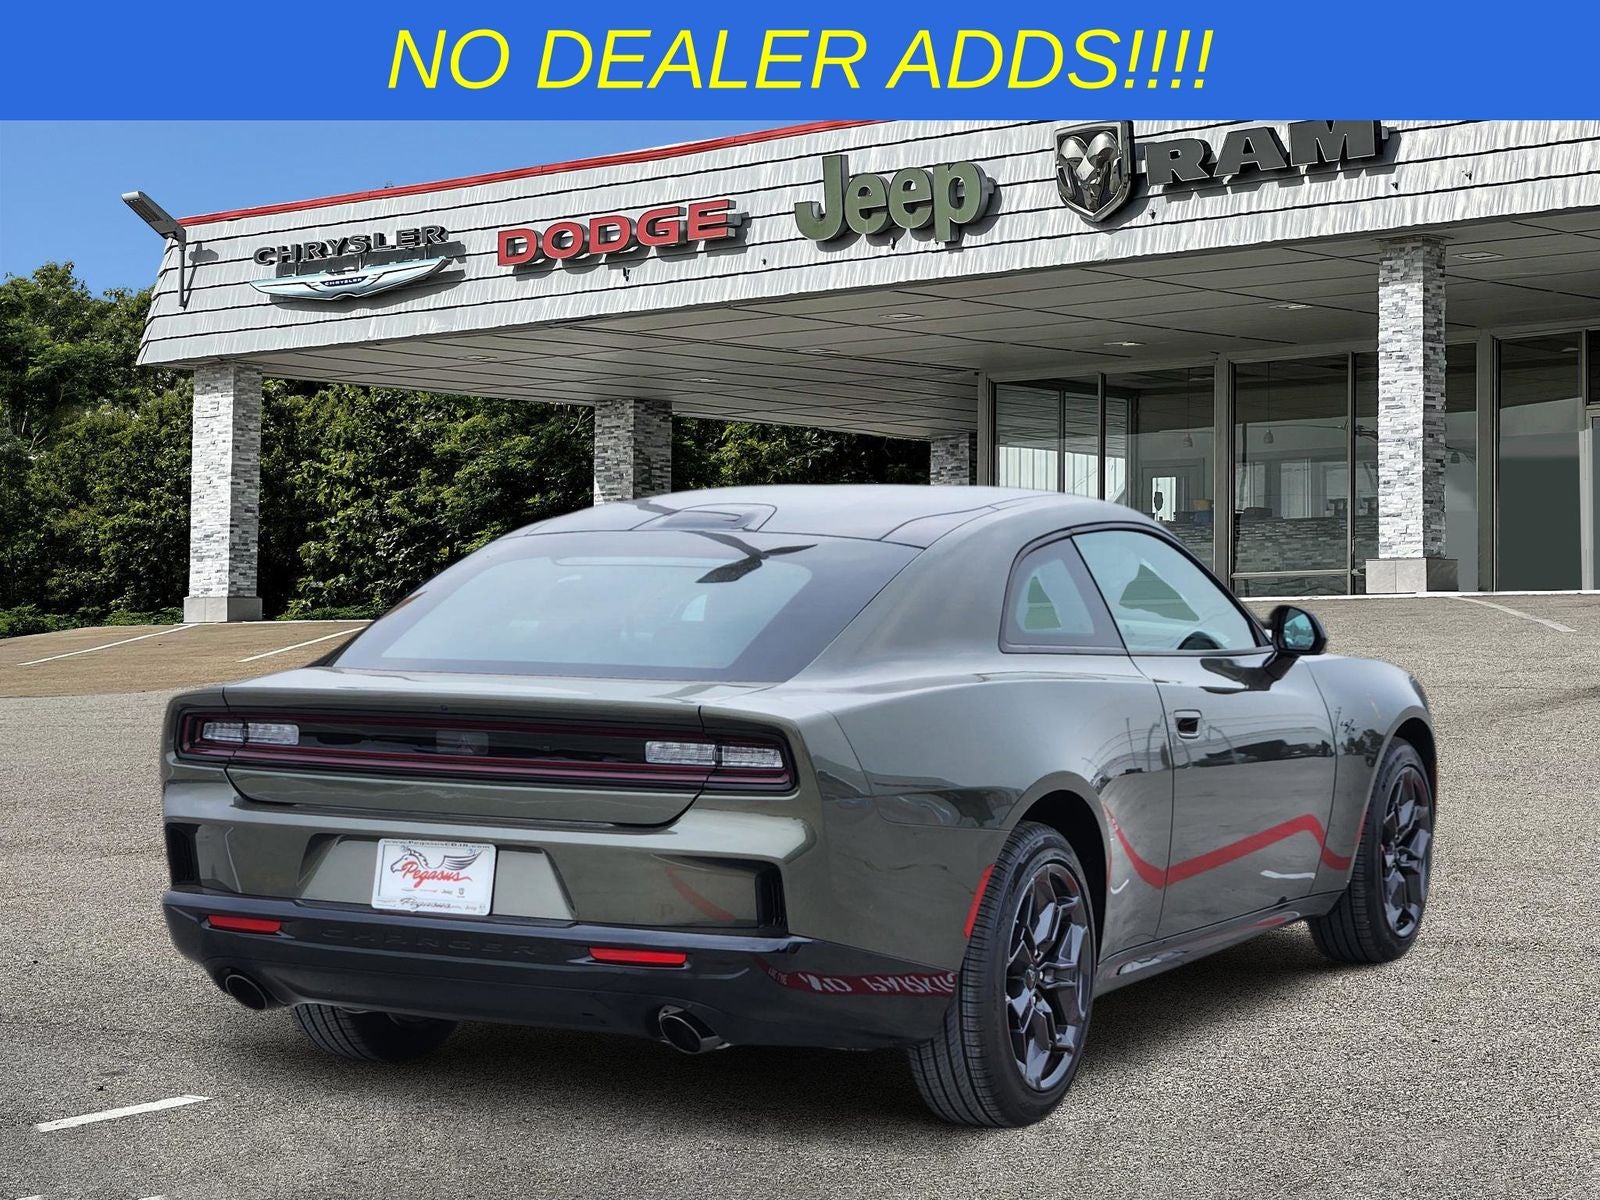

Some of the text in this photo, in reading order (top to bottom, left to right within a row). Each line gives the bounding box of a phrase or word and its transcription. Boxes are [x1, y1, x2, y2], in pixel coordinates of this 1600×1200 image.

[1144, 120, 1378, 186] RAM
[794, 154, 988, 243] Jeep
[252, 225, 449, 266] CHRYSLER
[497, 199, 736, 267] DODGE
[401, 860, 473, 888] Pegasus
